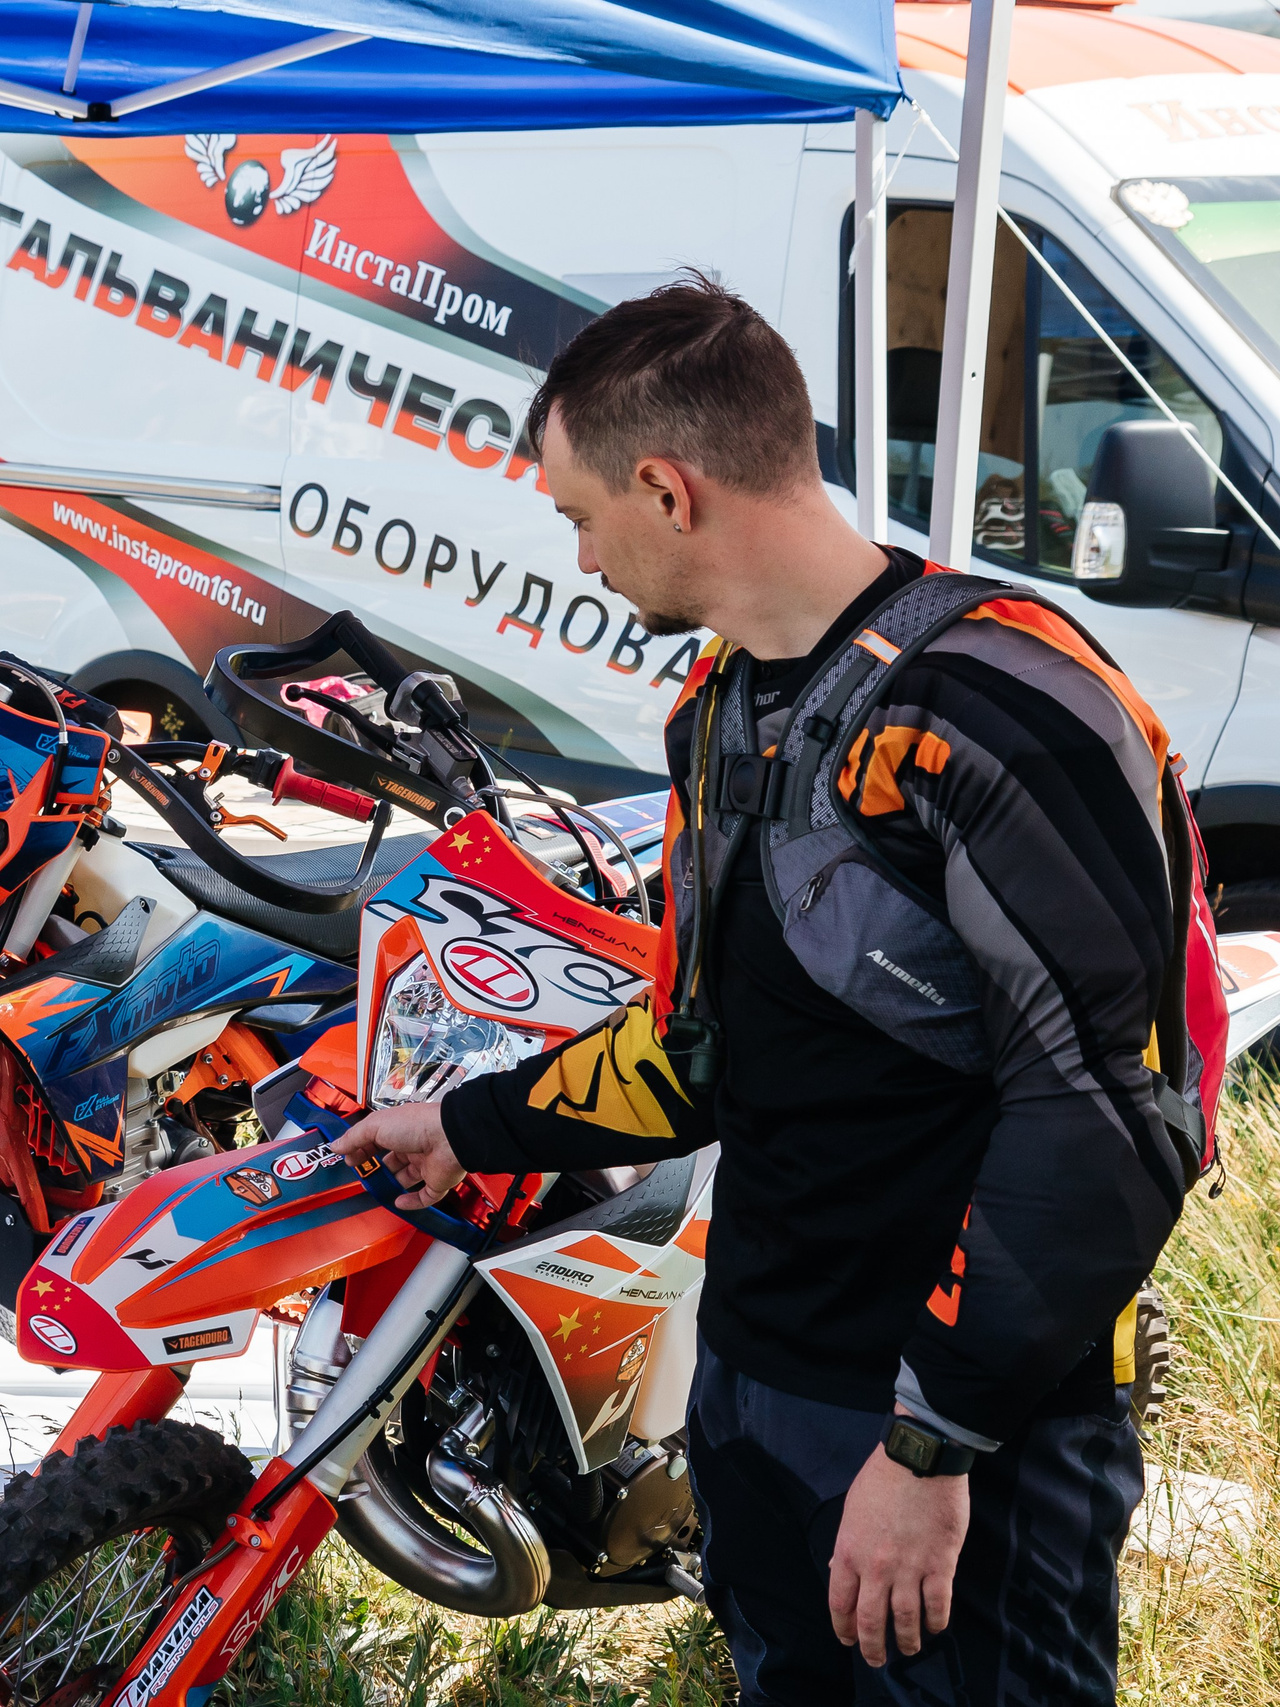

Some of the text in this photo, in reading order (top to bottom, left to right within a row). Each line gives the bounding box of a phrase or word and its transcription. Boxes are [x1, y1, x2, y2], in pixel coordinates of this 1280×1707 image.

[304, 217, 513, 338] ИнстаПром
[52, 499, 268, 627] www.instaprom161.ru
[754, 690, 781, 707] hor
[137, 774, 170, 807] TAGENDURO
[384, 780, 437, 812] TAGENDURO
[552, 911, 648, 960] HENGJIAN
[38, 937, 220, 1078] FXmoto
[535, 1260, 595, 1284] ENDURO
[177, 1328, 230, 1350] TAGENDURO
[136, 1587, 214, 1700] MAXIMA
[150, 1601, 219, 1696] RACING OILS
